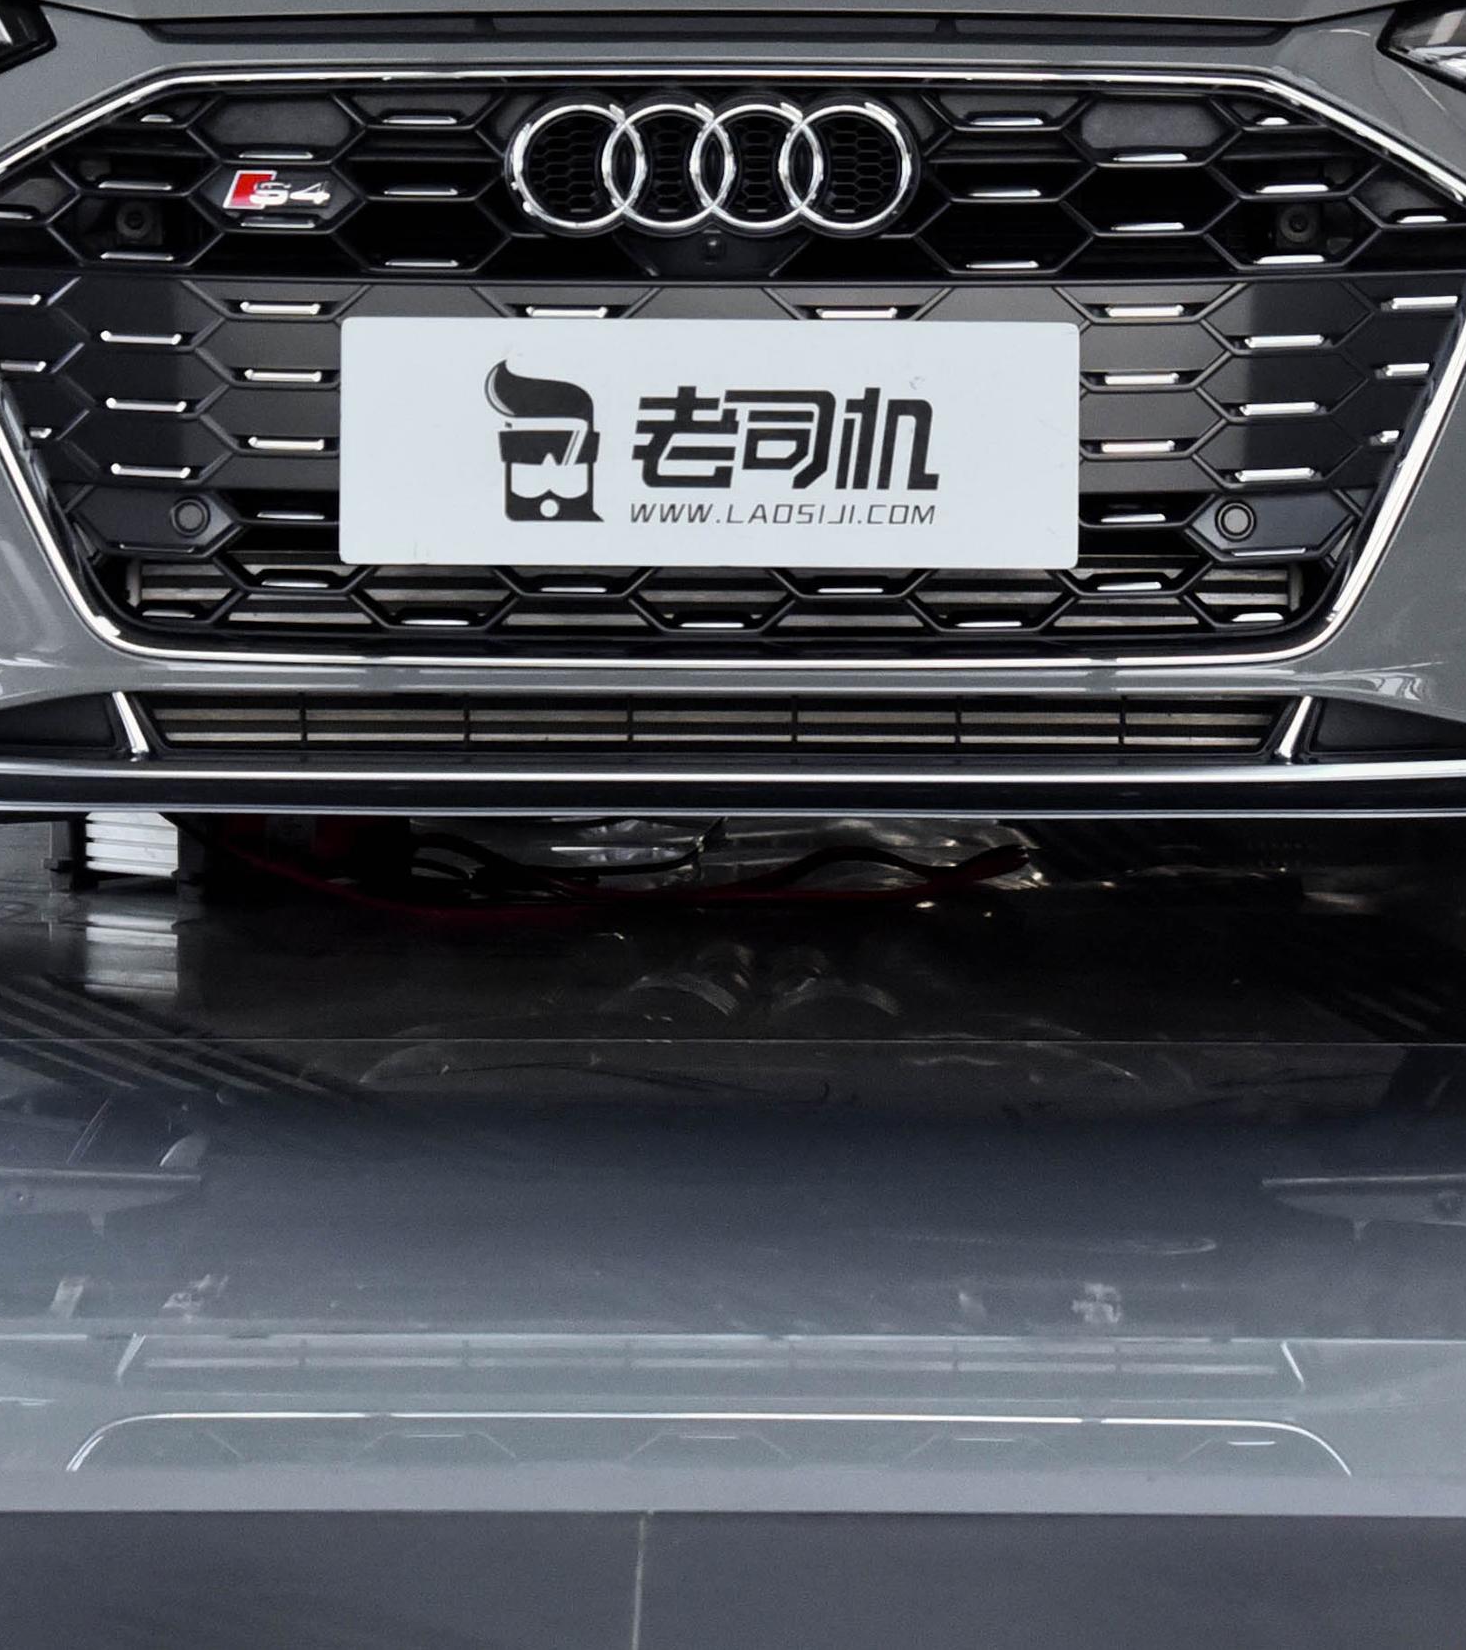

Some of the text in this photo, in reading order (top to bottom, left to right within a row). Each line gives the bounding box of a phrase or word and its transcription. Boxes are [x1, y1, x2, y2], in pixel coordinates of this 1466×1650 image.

[245, 179, 331, 206] S4
[631, 385, 940, 491] 老司机
[630, 503, 936, 525] WWW.LAOSIJI.COM
